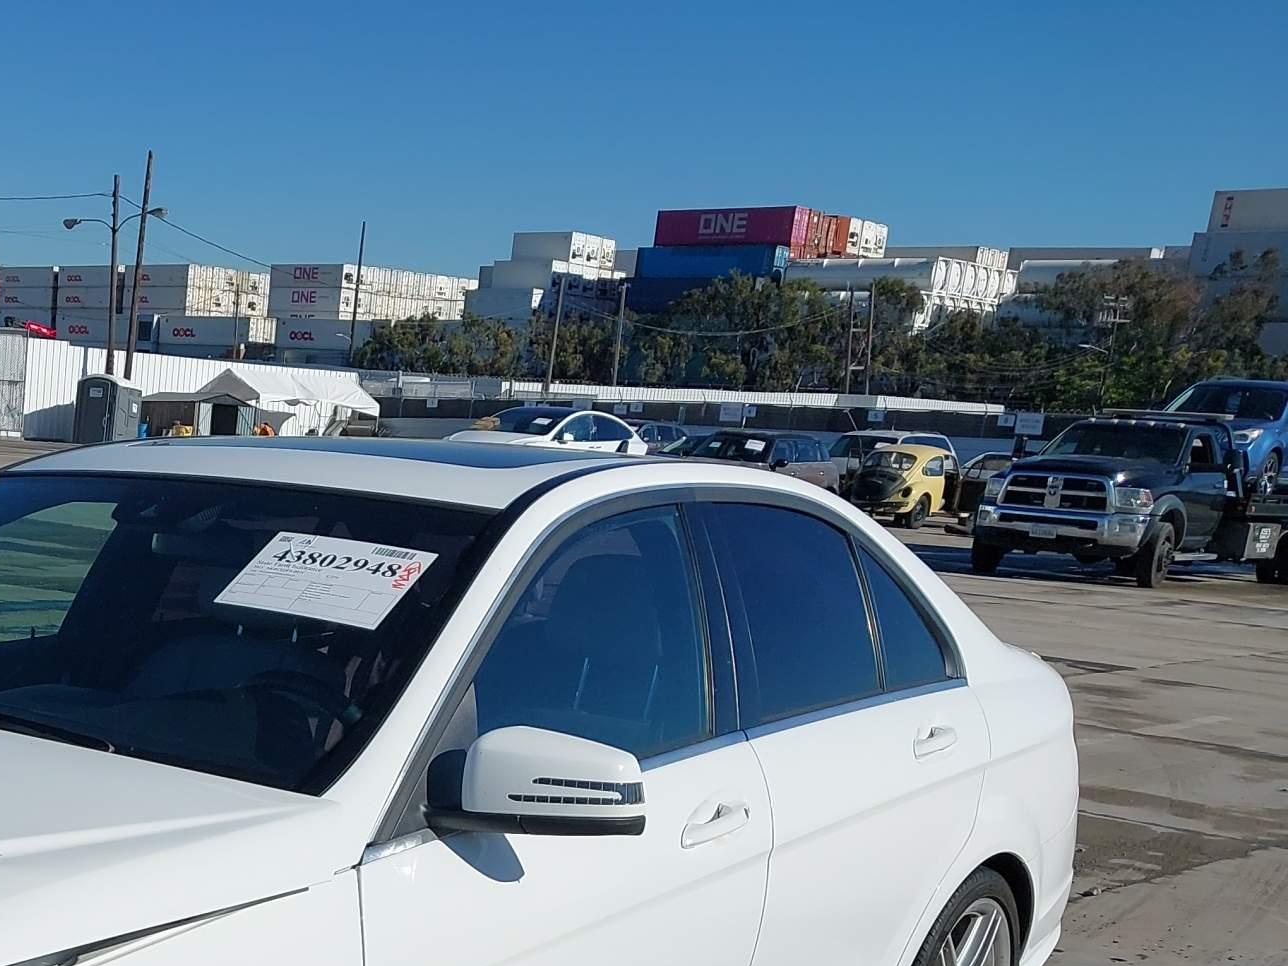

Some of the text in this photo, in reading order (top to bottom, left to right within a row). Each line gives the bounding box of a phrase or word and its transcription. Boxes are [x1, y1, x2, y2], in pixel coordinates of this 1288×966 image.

[698, 213, 748, 234] ONE
[67, 274, 82, 282] OOCL
[293, 267, 319, 280] ONE
[65, 295, 81, 303] OOCL
[291, 290, 317, 304] ONE
[68, 325, 89, 335] OOCL
[172, 327, 196, 338] OOCL
[289, 330, 314, 342] OOCL
[272, 548, 402, 578] 43802948
